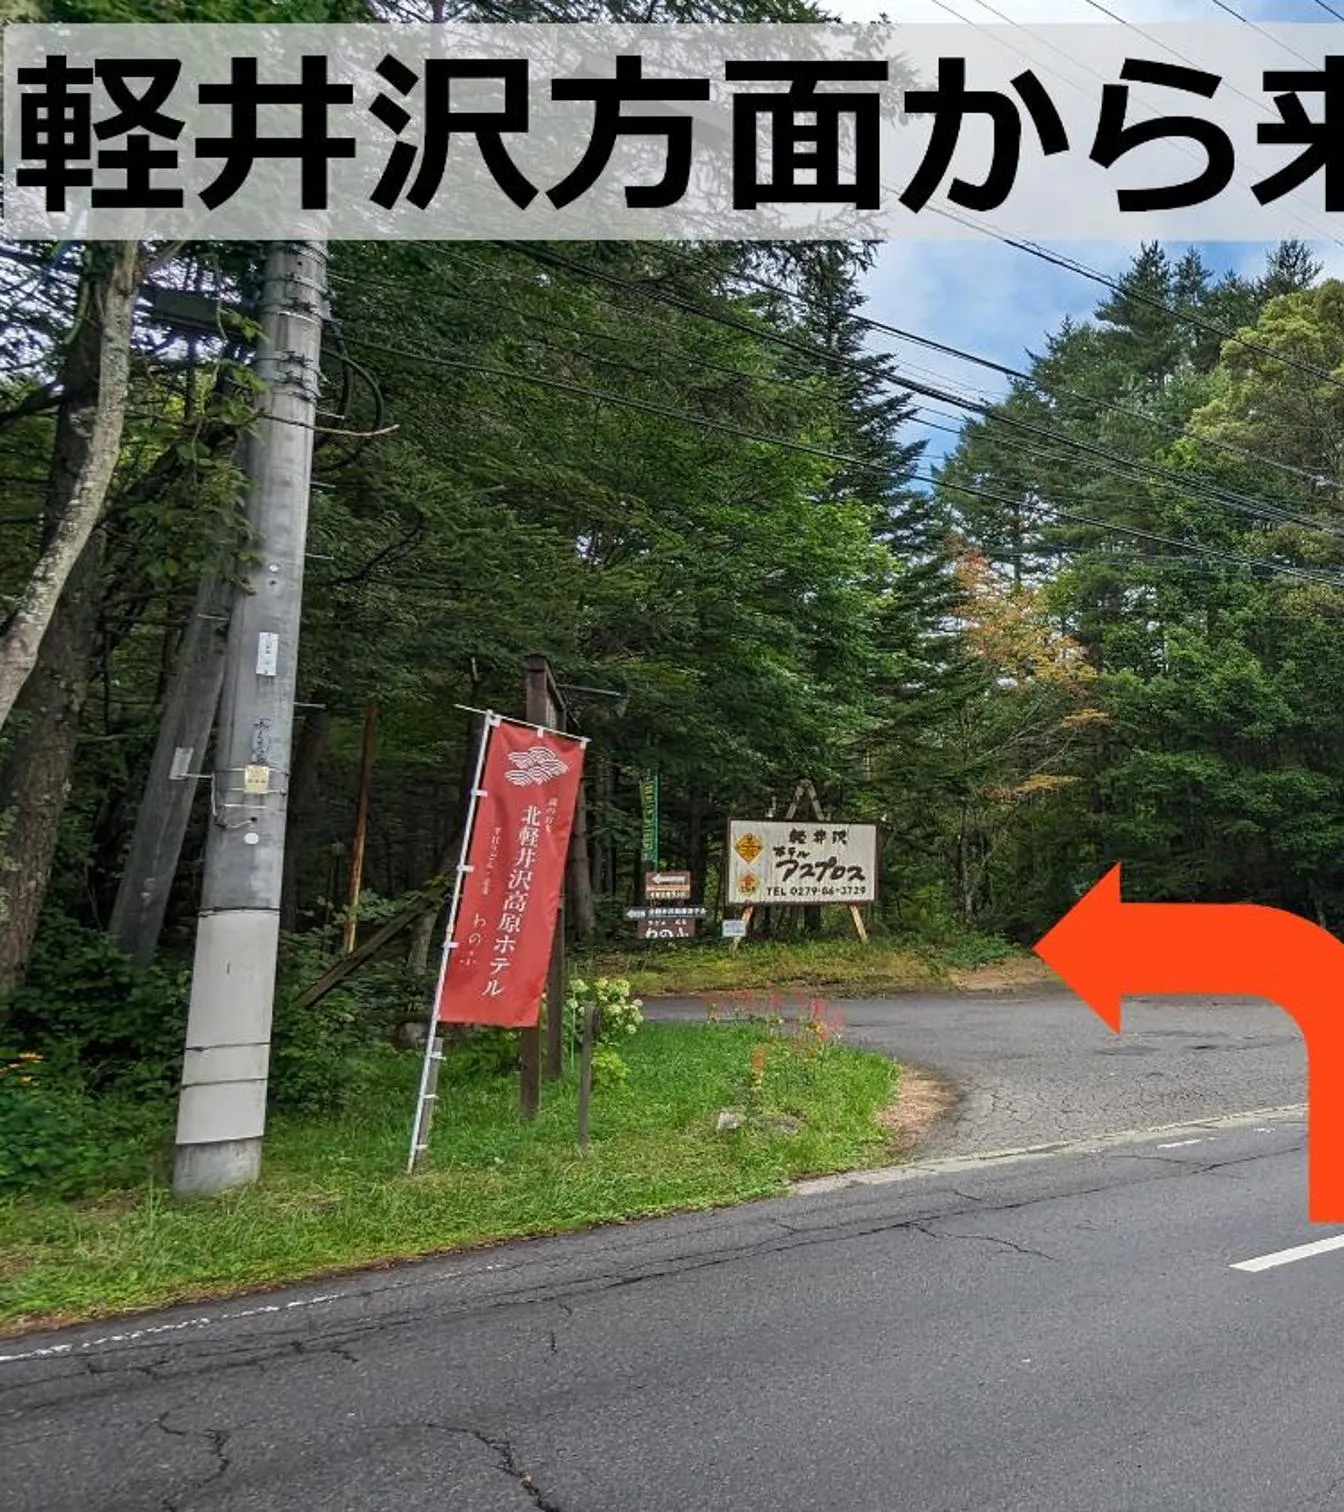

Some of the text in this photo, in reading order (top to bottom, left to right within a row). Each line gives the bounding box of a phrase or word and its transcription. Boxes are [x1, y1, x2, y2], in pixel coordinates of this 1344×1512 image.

[483, 804, 541, 997] 北軽井沢高原ホテル
[767, 886, 787, 896] TEL
